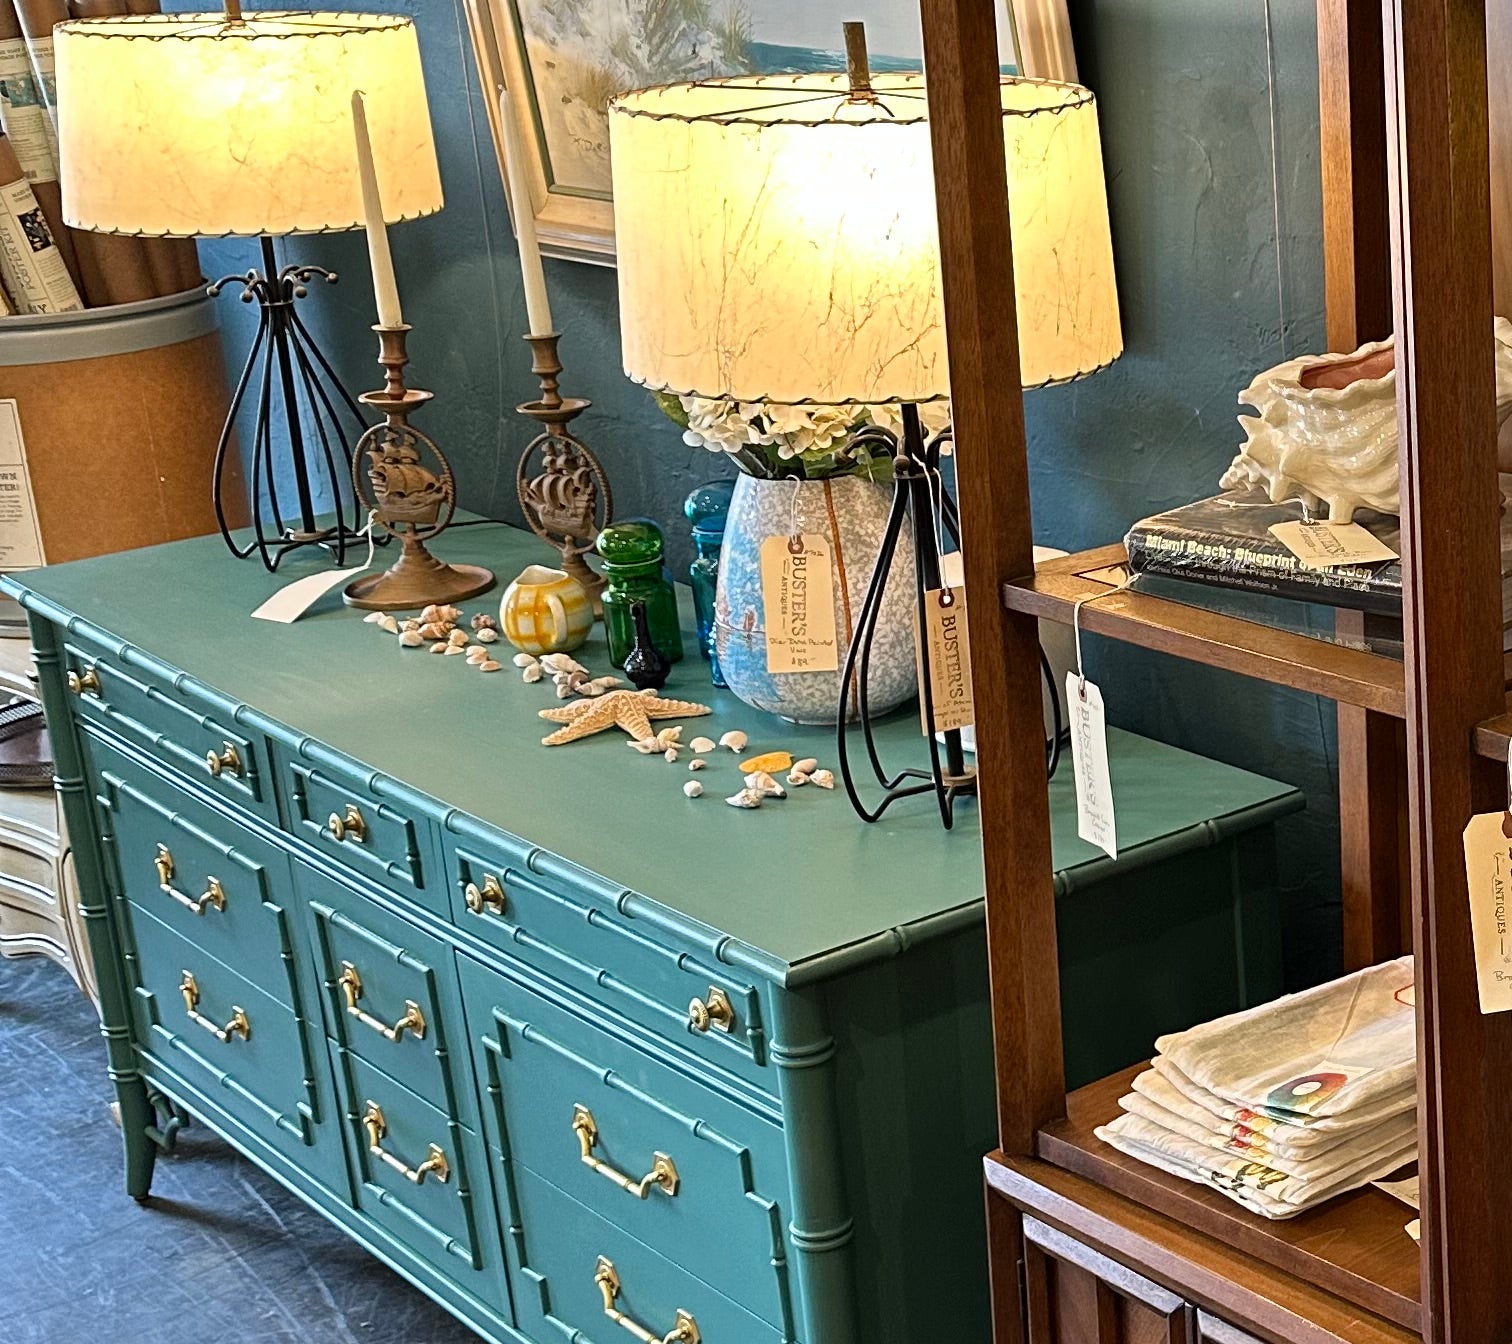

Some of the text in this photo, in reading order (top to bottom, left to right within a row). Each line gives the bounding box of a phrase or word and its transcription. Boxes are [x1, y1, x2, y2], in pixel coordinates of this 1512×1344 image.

[1145, 534, 1186, 552] Miami
[1187, 540, 1232, 559] Beach:
[1234, 547, 1297, 570] Blueprint
[791, 556, 807, 637] BUSTER'S
[940, 614, 964, 700] BUSTER'S
[1493, 878, 1507, 935] ANTIQUES
